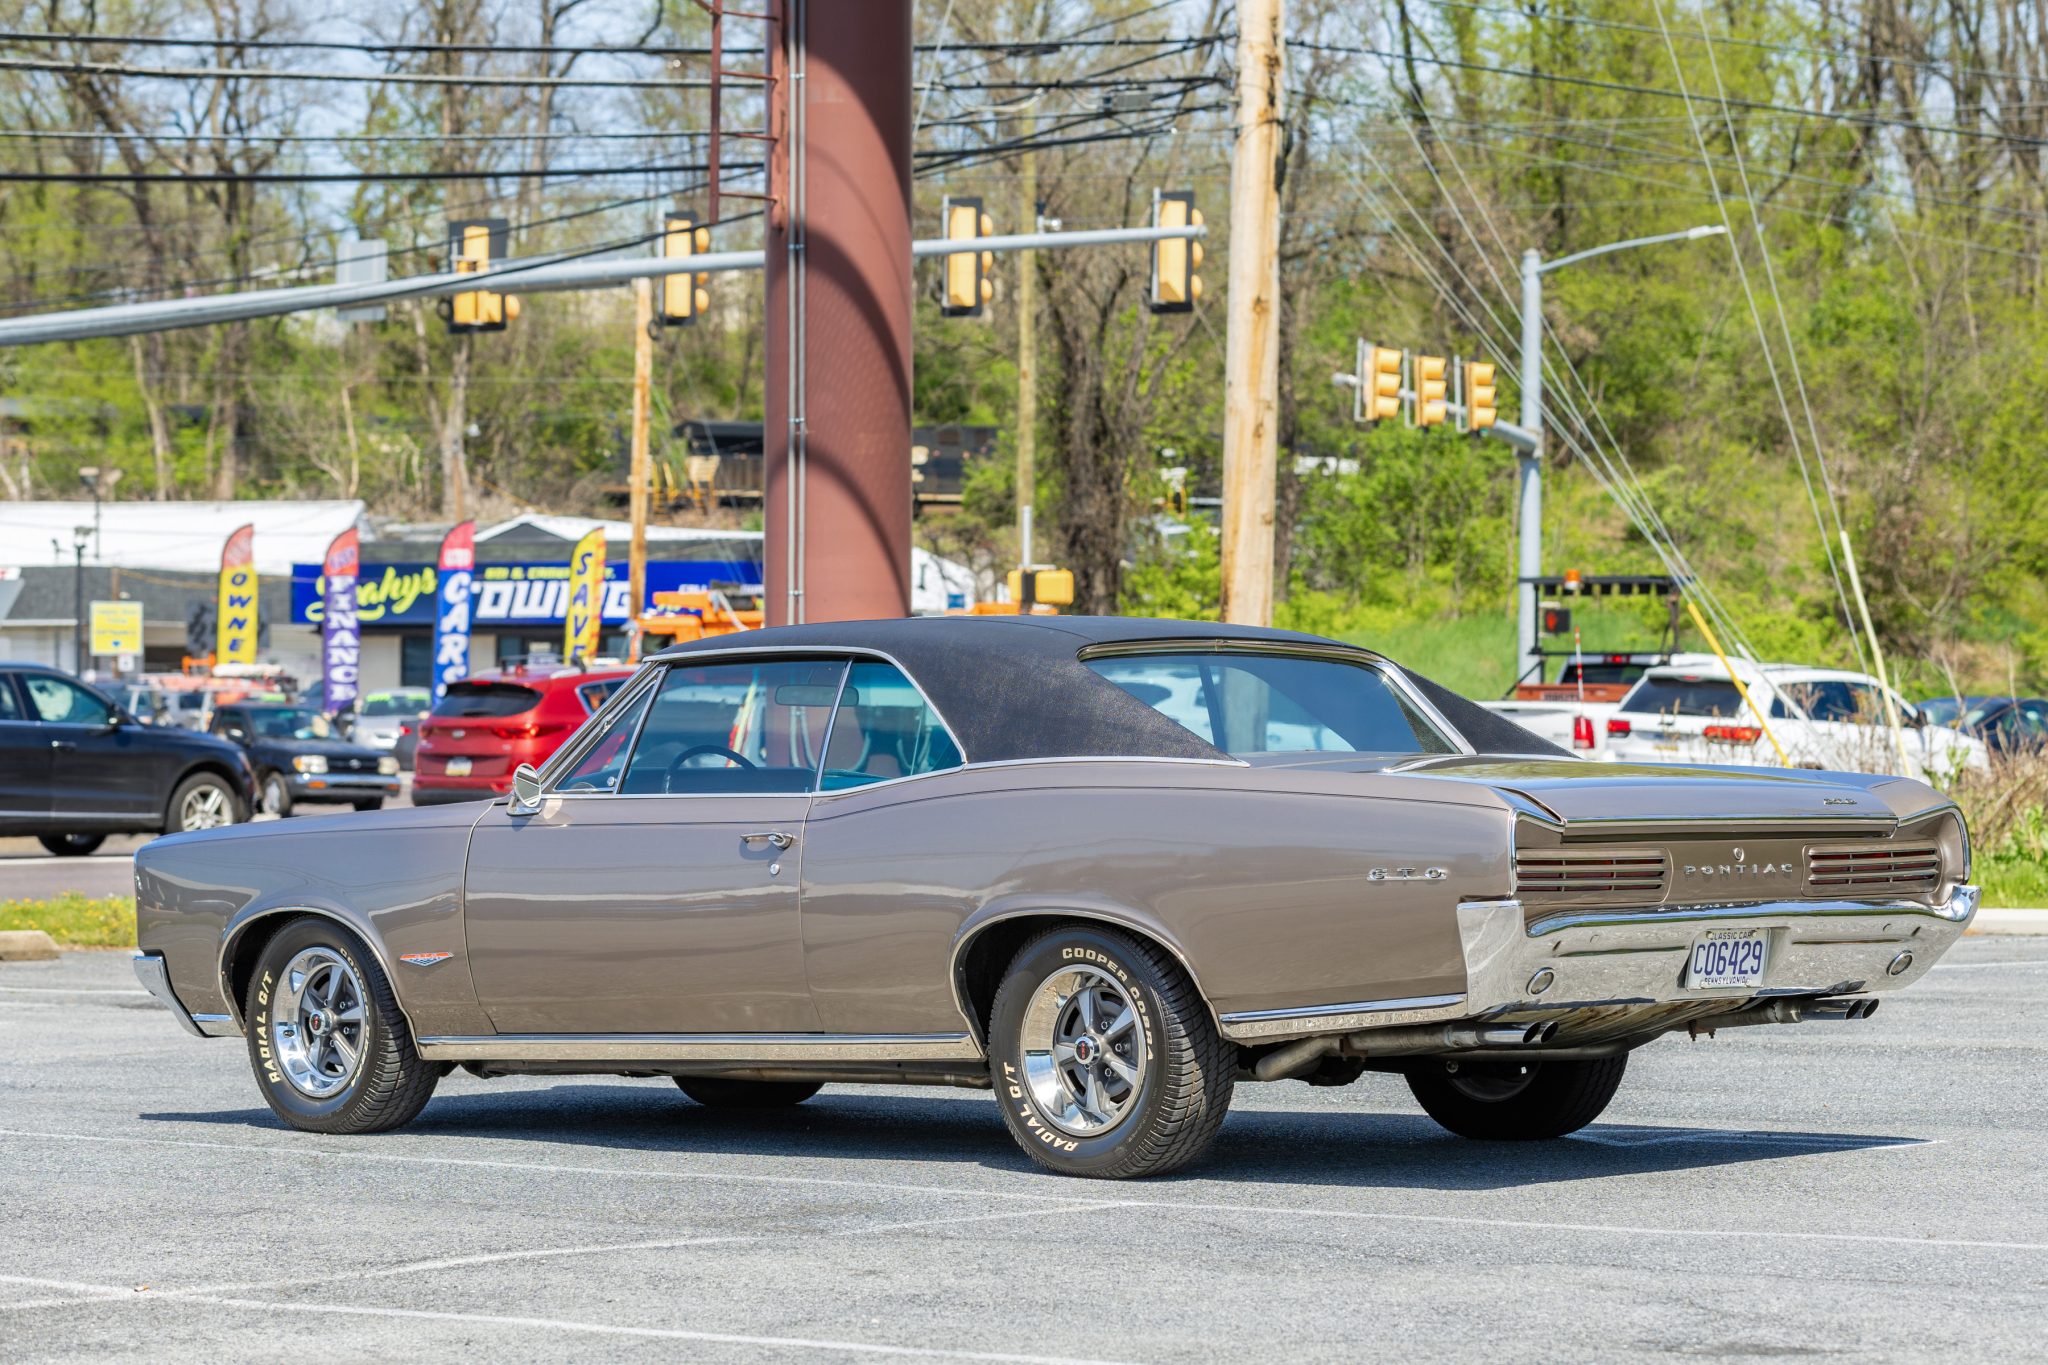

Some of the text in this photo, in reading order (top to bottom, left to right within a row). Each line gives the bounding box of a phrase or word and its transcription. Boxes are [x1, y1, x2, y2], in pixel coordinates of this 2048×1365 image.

[228, 573, 251, 664] OWNE
[326, 575, 359, 701] FINANCE
[1367, 867, 1450, 881] GTO
[1683, 863, 1793, 875] PONTIAC
[256, 1011, 281, 1083] RADIAL
[1062, 947, 1128, 983] COOPER
[1129, 986, 1154, 1061] COBRA
[1003, 1062, 1079, 1152] RADIAL G/T
